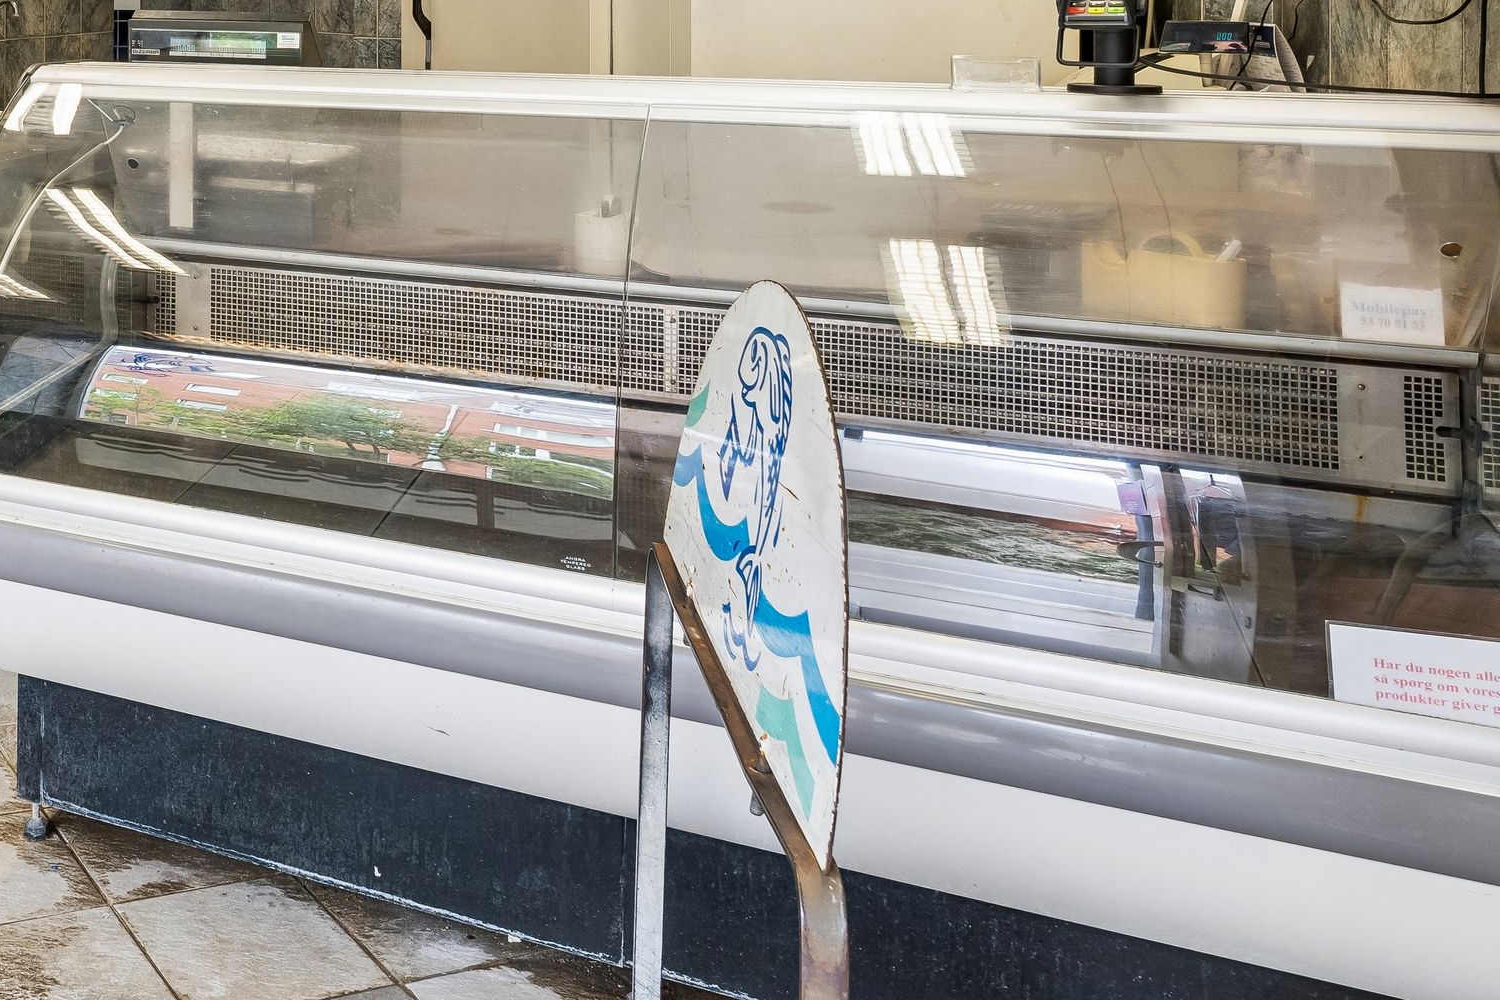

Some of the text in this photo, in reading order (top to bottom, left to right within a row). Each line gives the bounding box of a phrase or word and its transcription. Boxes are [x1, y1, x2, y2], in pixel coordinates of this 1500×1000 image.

[1373, 658, 1401, 670] Har
[1405, 662, 1423, 673] du
[1428, 666, 1471, 679] nogen
[1374, 674, 1388, 684] så
[1392, 677, 1433, 691] spørg
[1437, 683, 1459, 693] om
[1375, 690, 1448, 706] produkter
[1452, 699, 1488, 711] giver
